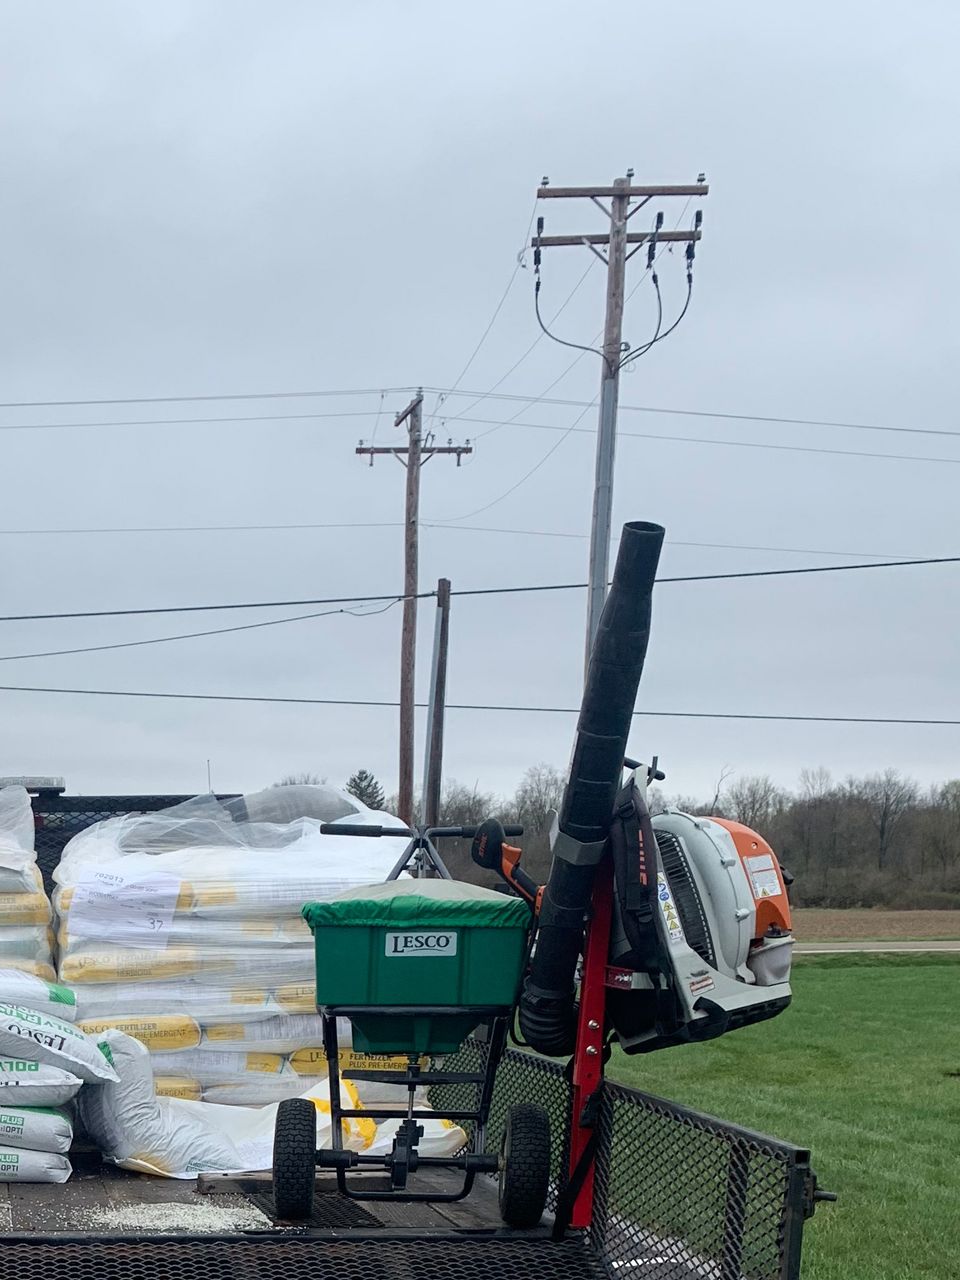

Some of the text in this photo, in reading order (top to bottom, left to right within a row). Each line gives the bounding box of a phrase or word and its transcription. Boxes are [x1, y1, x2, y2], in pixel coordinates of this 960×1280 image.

[147, 917, 164, 931] 37
[392, 935, 450, 953] LESCO
[115, 1022, 157, 1031] FERTILIZER
[349, 1061, 407, 1070] PLUS PRE-EMERG
[1, 1116, 23, 1125] PLUS
[5, 1125, 23, 1135] OPTI
[0, 1164, 19, 1172] OPTI
